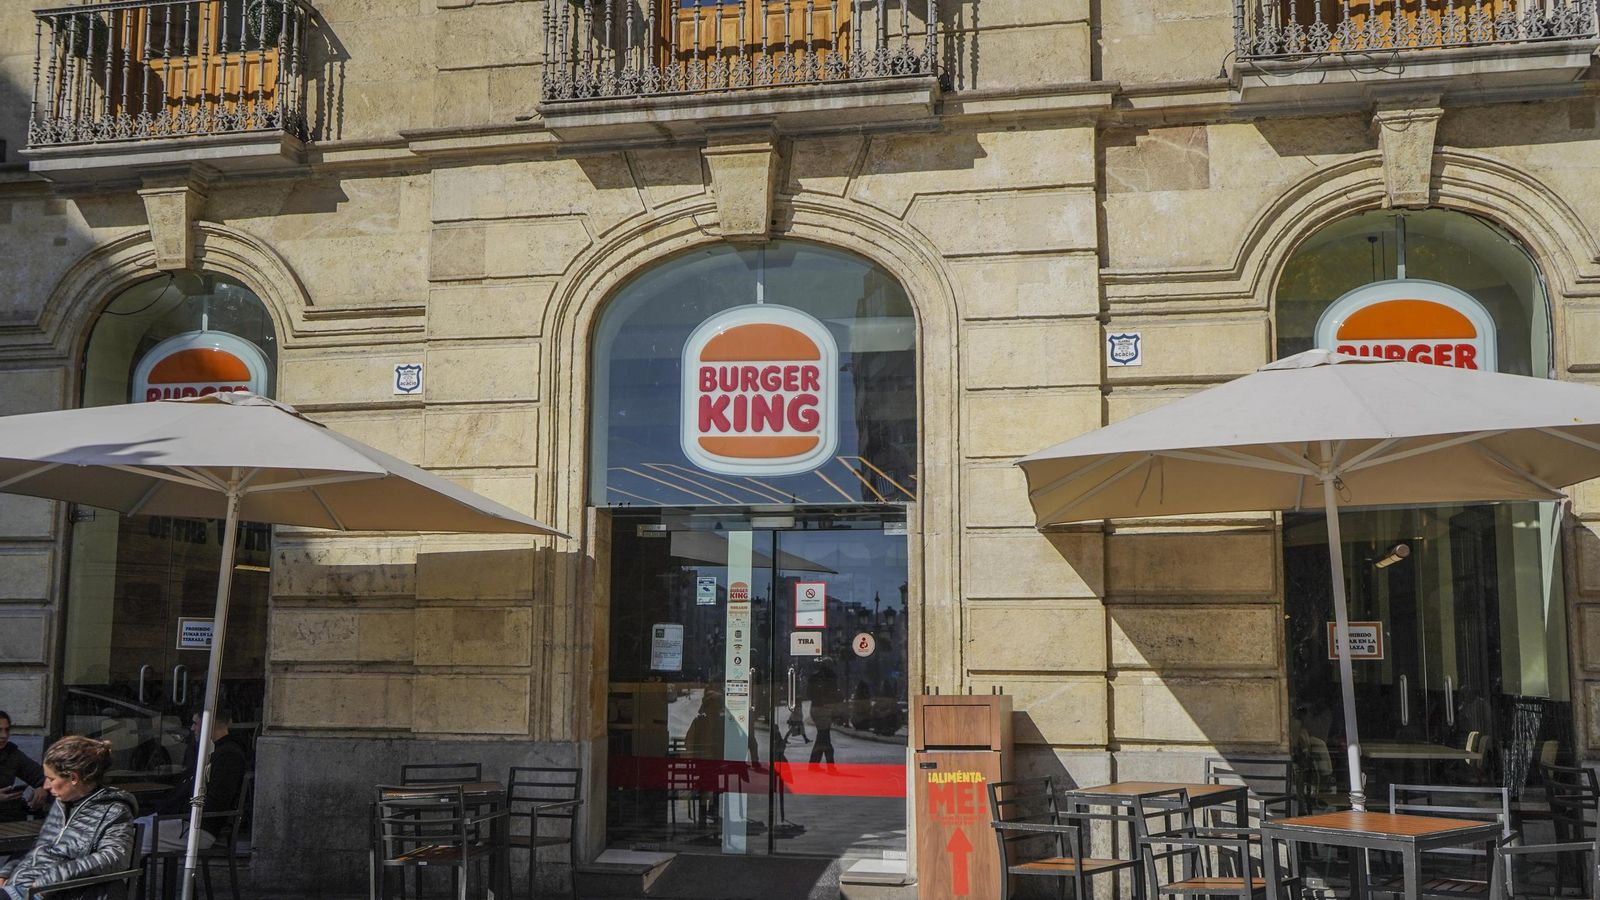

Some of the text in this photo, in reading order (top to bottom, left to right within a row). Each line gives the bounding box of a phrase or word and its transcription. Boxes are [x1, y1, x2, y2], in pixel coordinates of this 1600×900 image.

[699, 365, 821, 392] BURGER
[698, 394, 820, 433] KING
[928, 782, 986, 814] ME!
